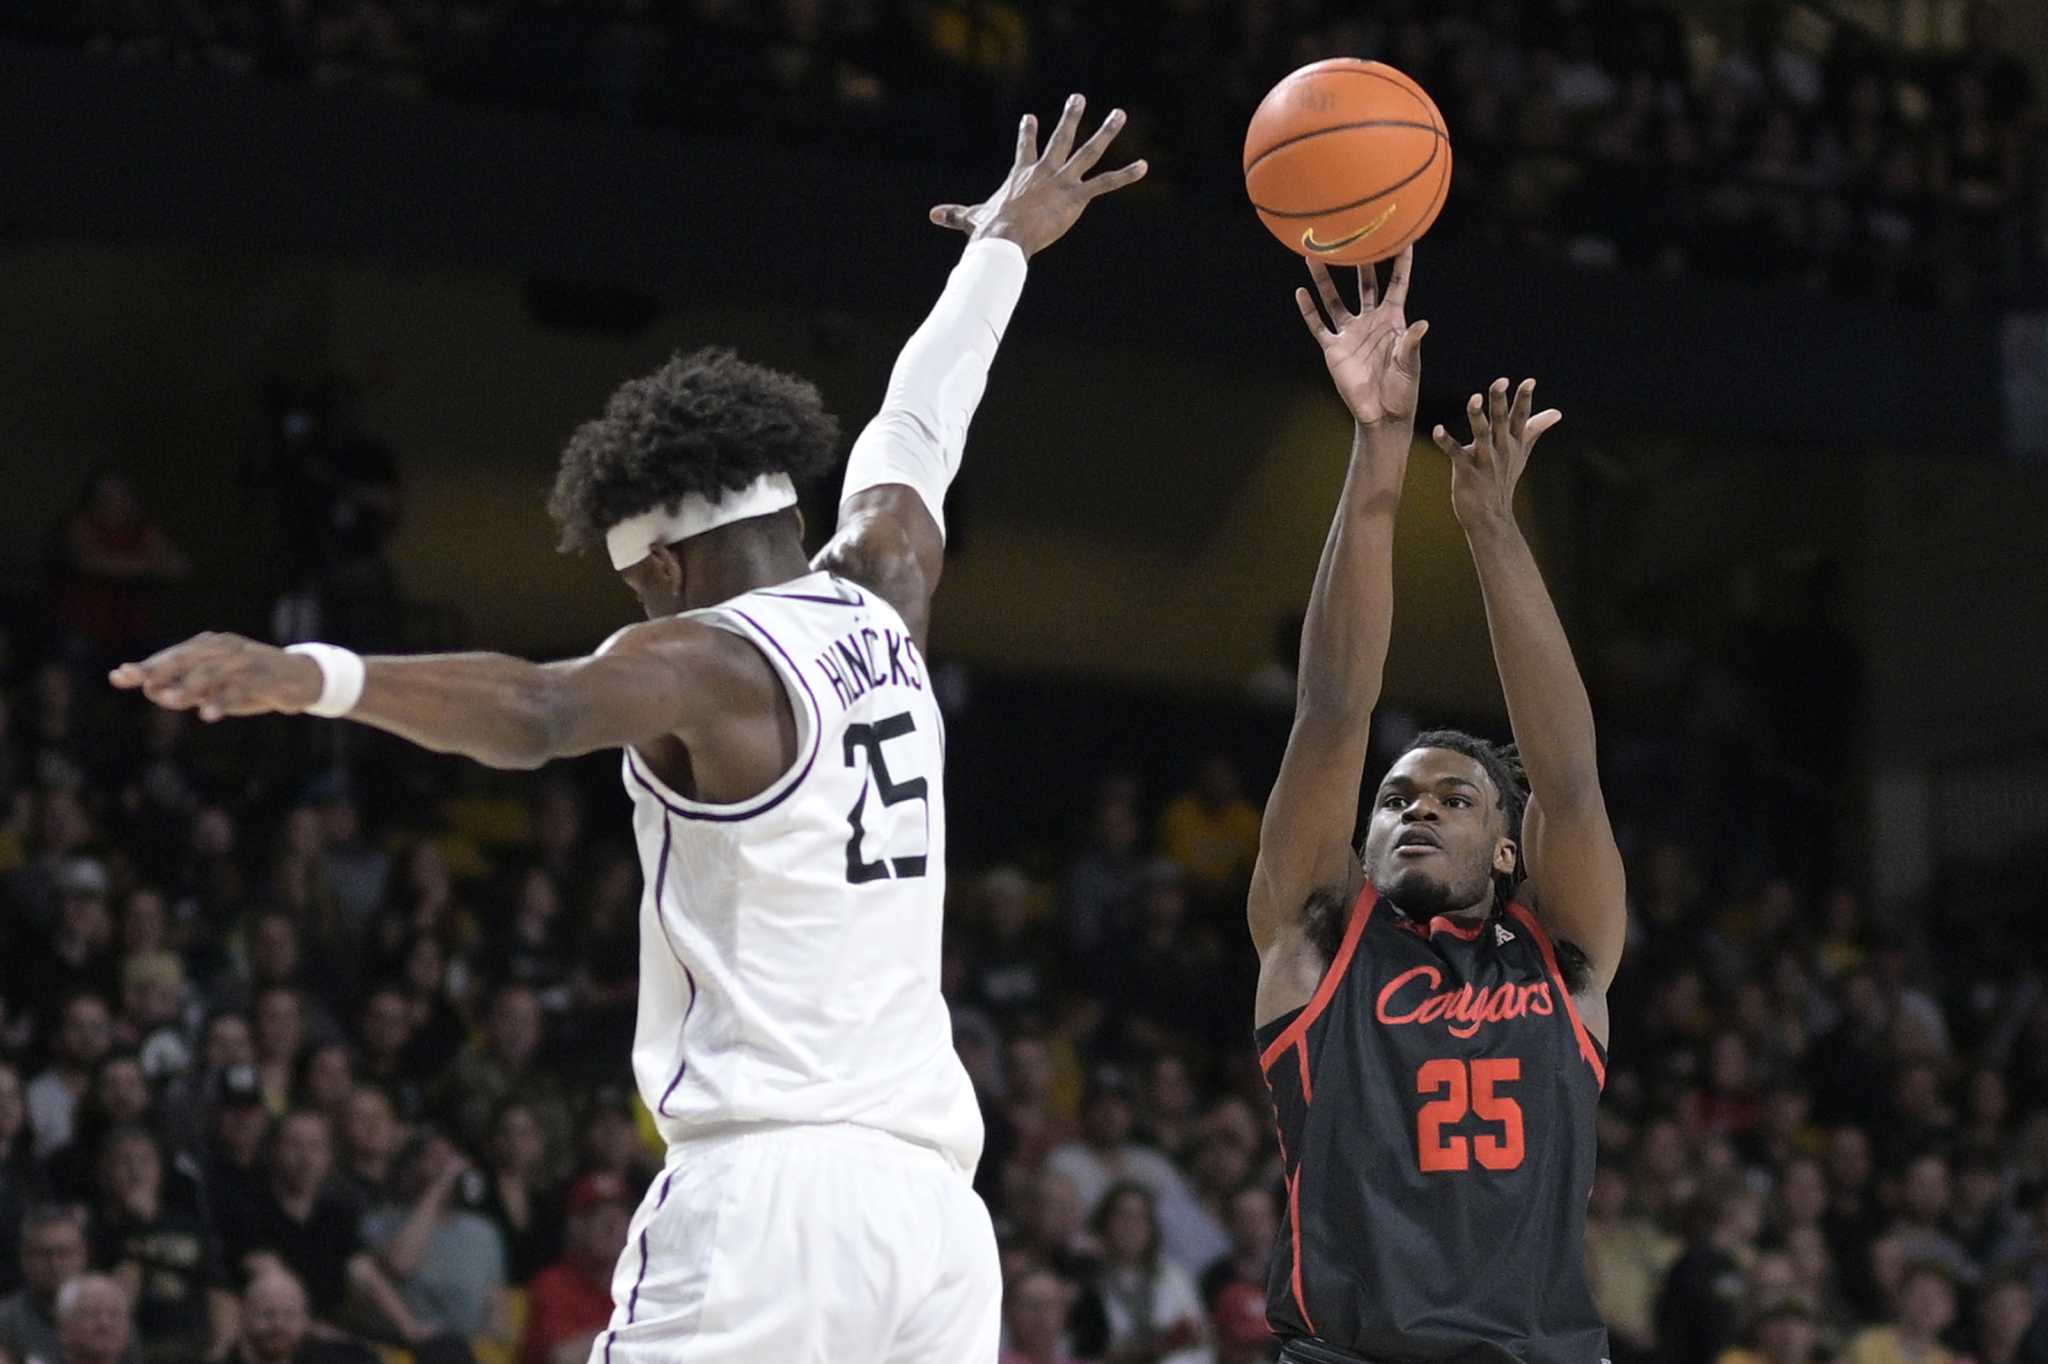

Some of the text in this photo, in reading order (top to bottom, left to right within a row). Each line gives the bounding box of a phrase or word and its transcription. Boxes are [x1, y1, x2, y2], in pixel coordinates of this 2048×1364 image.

[843, 711, 928, 884] 25
[1376, 965, 1553, 1039] Cougars
[1417, 1058, 1525, 1171] 25
